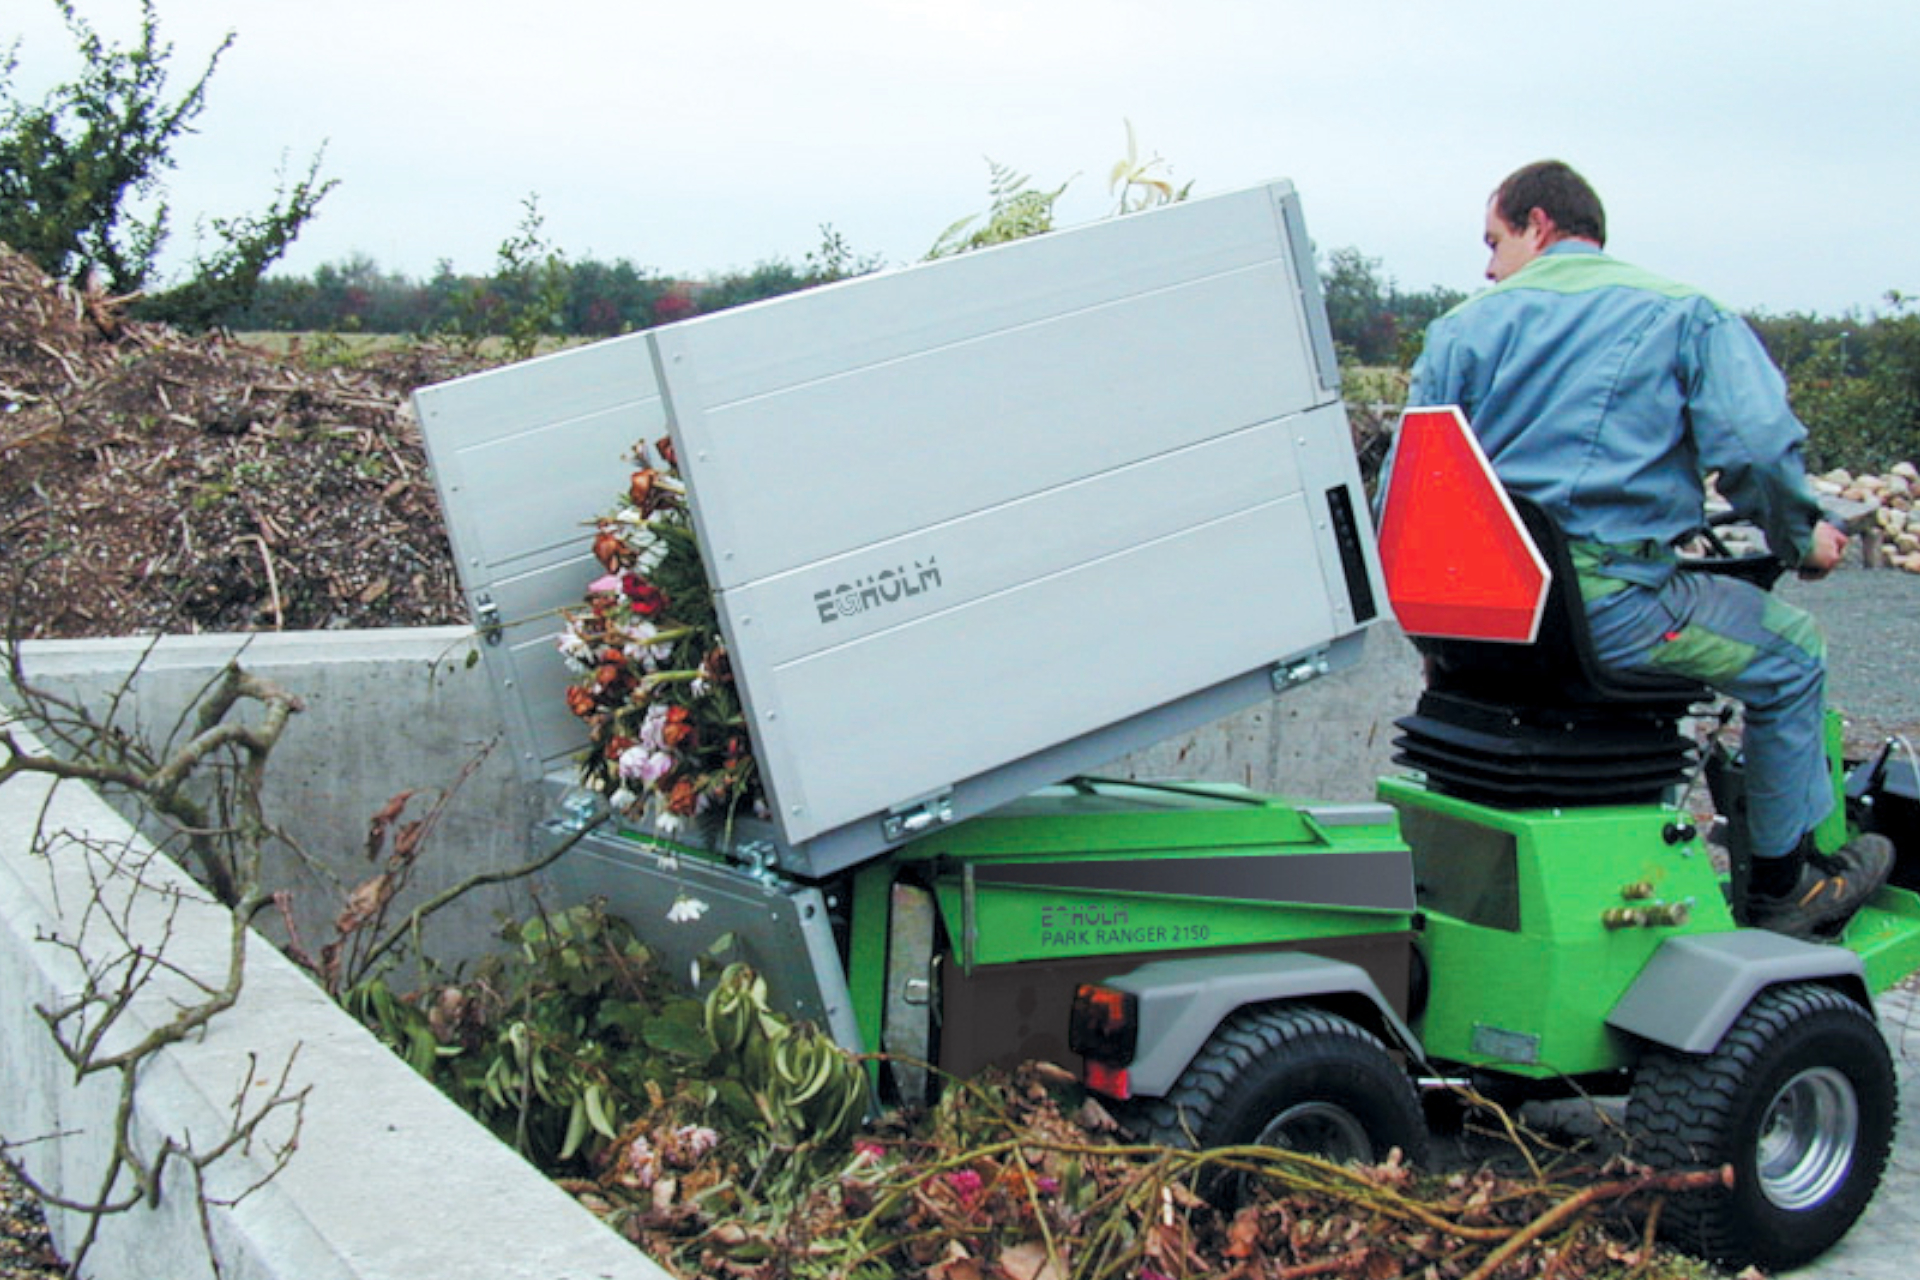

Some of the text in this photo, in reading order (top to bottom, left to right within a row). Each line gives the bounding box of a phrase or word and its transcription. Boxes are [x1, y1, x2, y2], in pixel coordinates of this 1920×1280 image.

[814, 556, 941, 623] EGHOLM
[1042, 924, 1209, 947] PARK RANGER 2150
